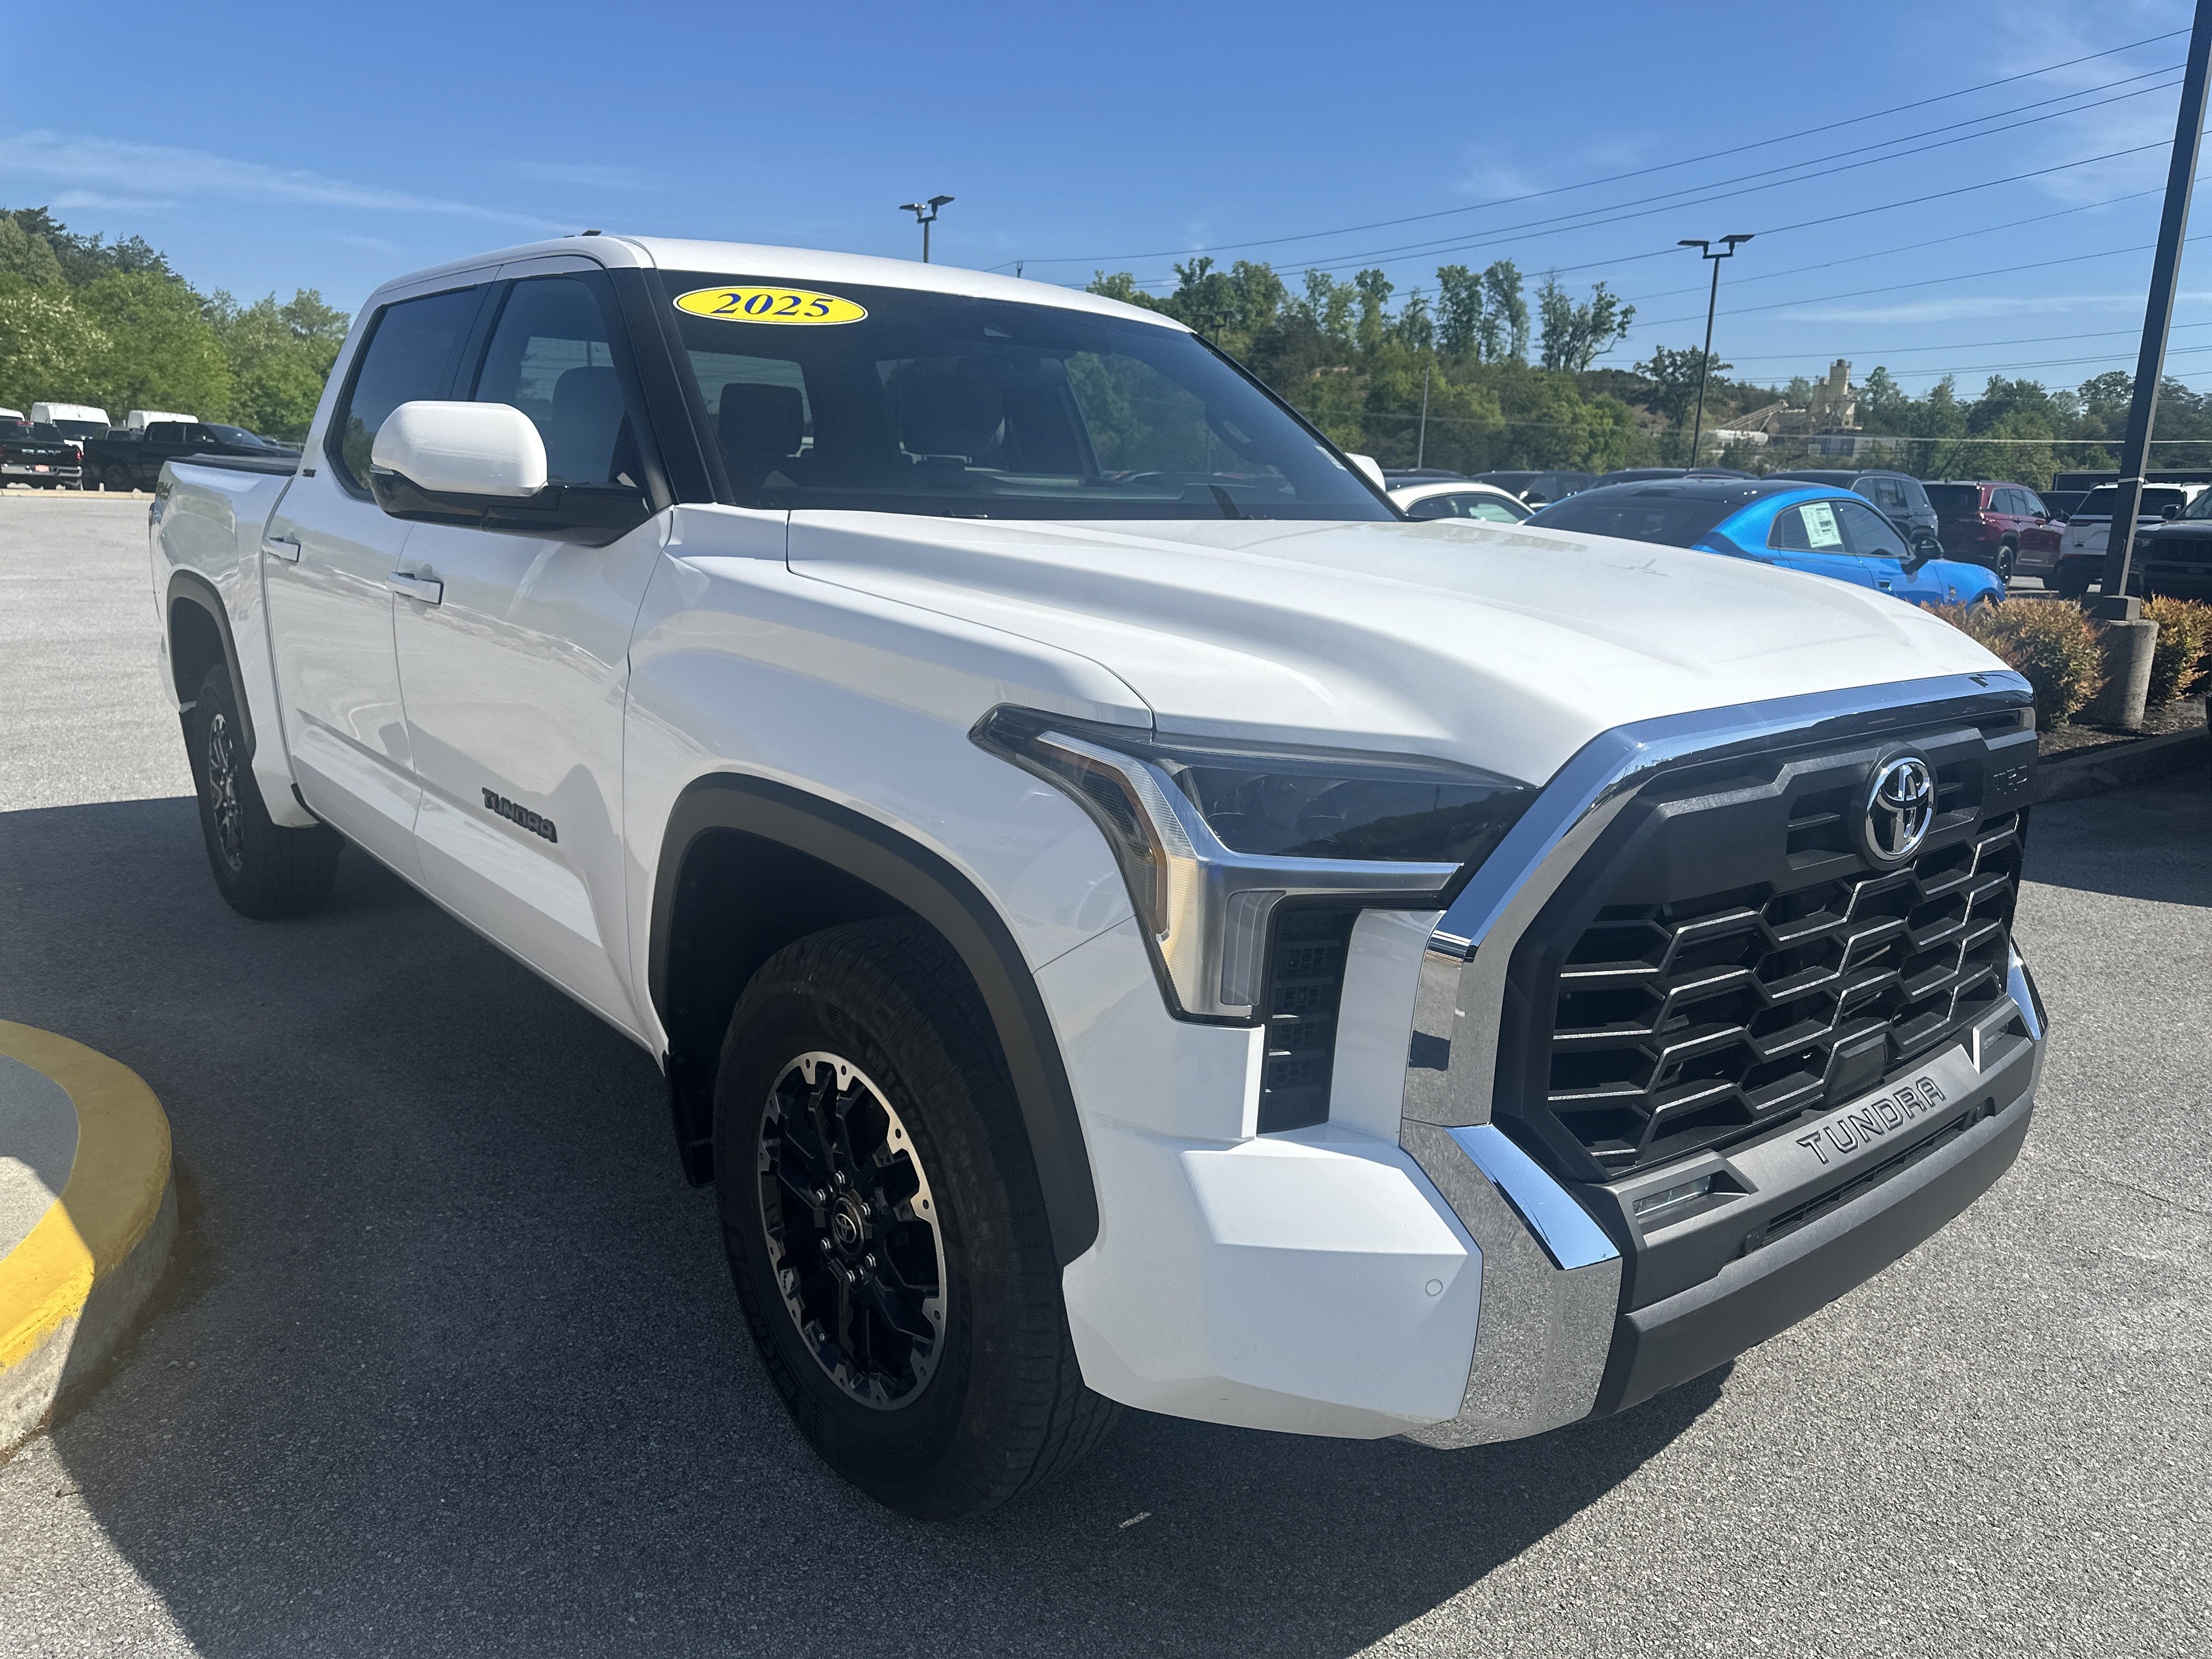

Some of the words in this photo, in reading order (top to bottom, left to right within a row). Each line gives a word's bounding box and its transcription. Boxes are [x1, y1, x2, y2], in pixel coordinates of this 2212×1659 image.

[710, 293, 834, 317] 2025
[482, 787, 558, 844] TUNDRA
[1796, 1076, 1947, 1165] TUNDRA
